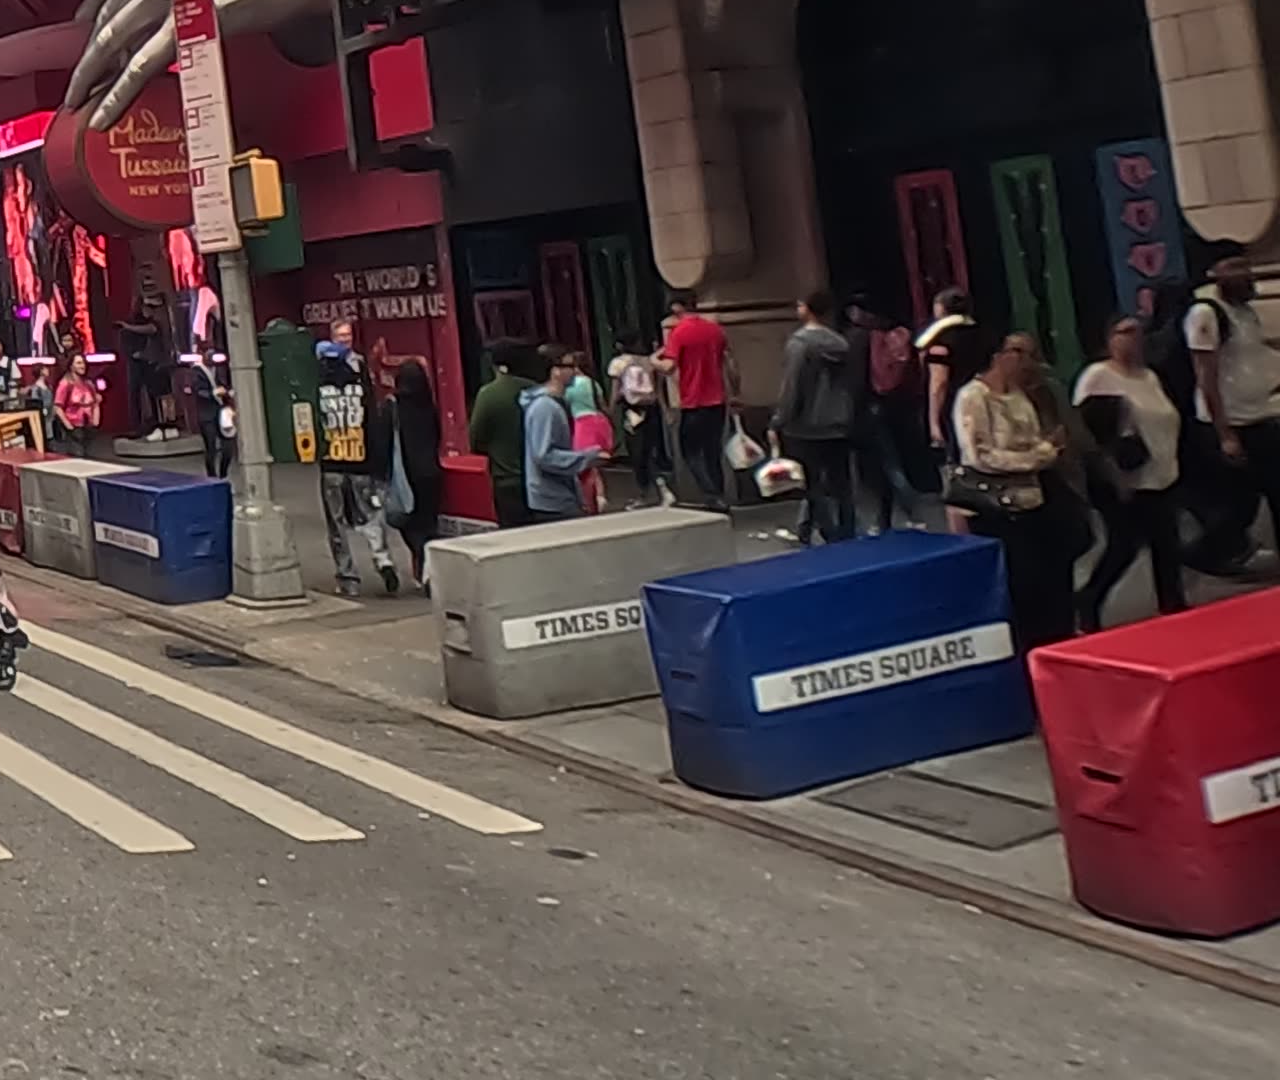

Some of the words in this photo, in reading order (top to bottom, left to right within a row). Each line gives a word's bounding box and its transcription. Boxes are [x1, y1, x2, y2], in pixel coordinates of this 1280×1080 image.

[108, 143, 189, 179] Tussau
[129, 184, 160, 196] NEW
[534, 610, 610, 640] TIMES
[790, 660, 874, 698] TIMES
[878, 635, 977, 679] SQUARE
